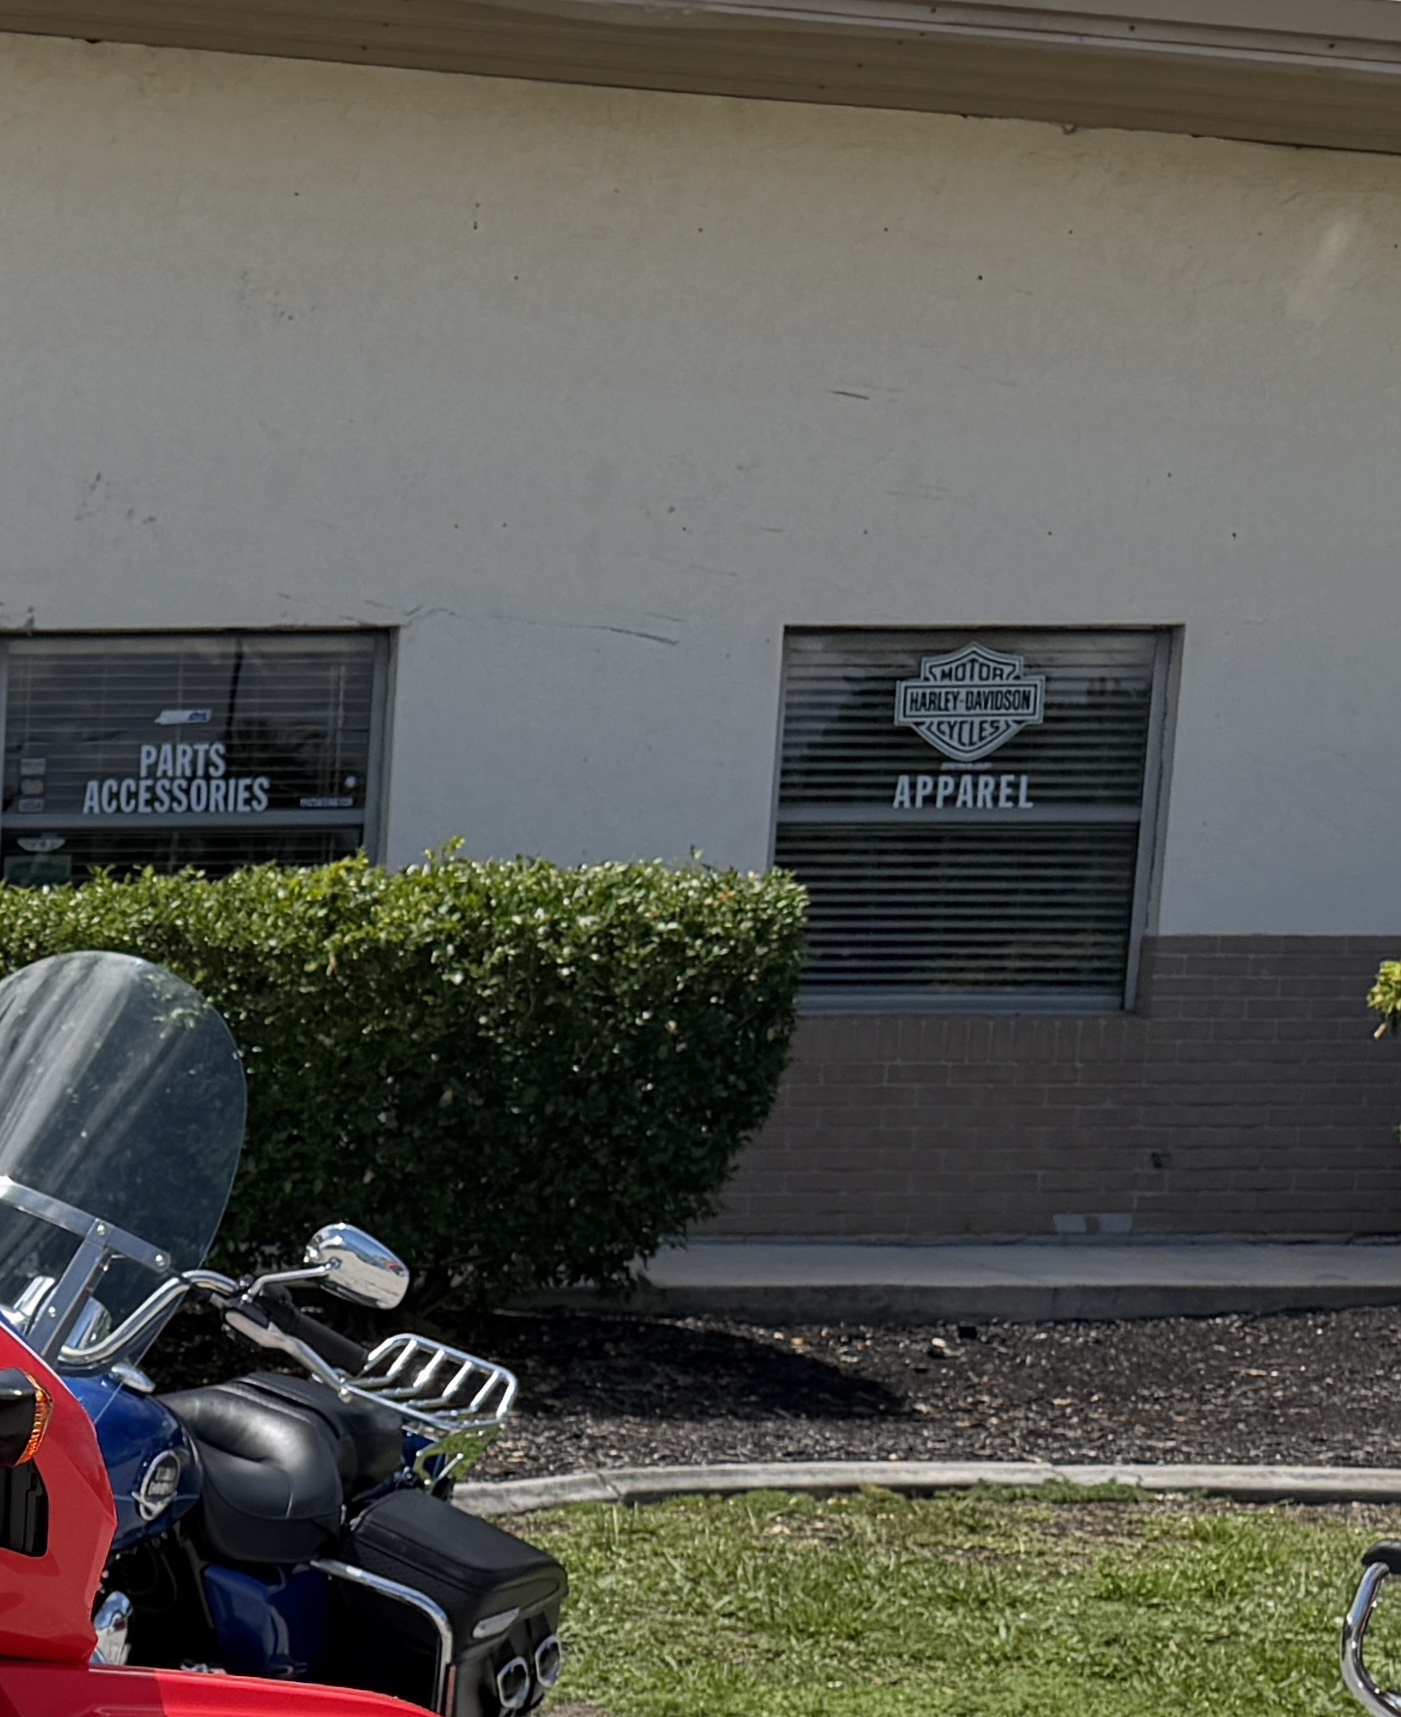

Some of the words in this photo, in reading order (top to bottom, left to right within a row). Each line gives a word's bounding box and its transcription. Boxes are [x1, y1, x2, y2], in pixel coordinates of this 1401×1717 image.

[940, 658, 1004, 682] MOTOR
[909, 689, 1031, 712] HARLEY-DAVIDSON
[937, 720, 1000, 747] CYCLES
[140, 742, 225, 778] PARTS
[83, 777, 270, 815] ACCESSORIES
[893, 774, 1034, 809] APPAREL
